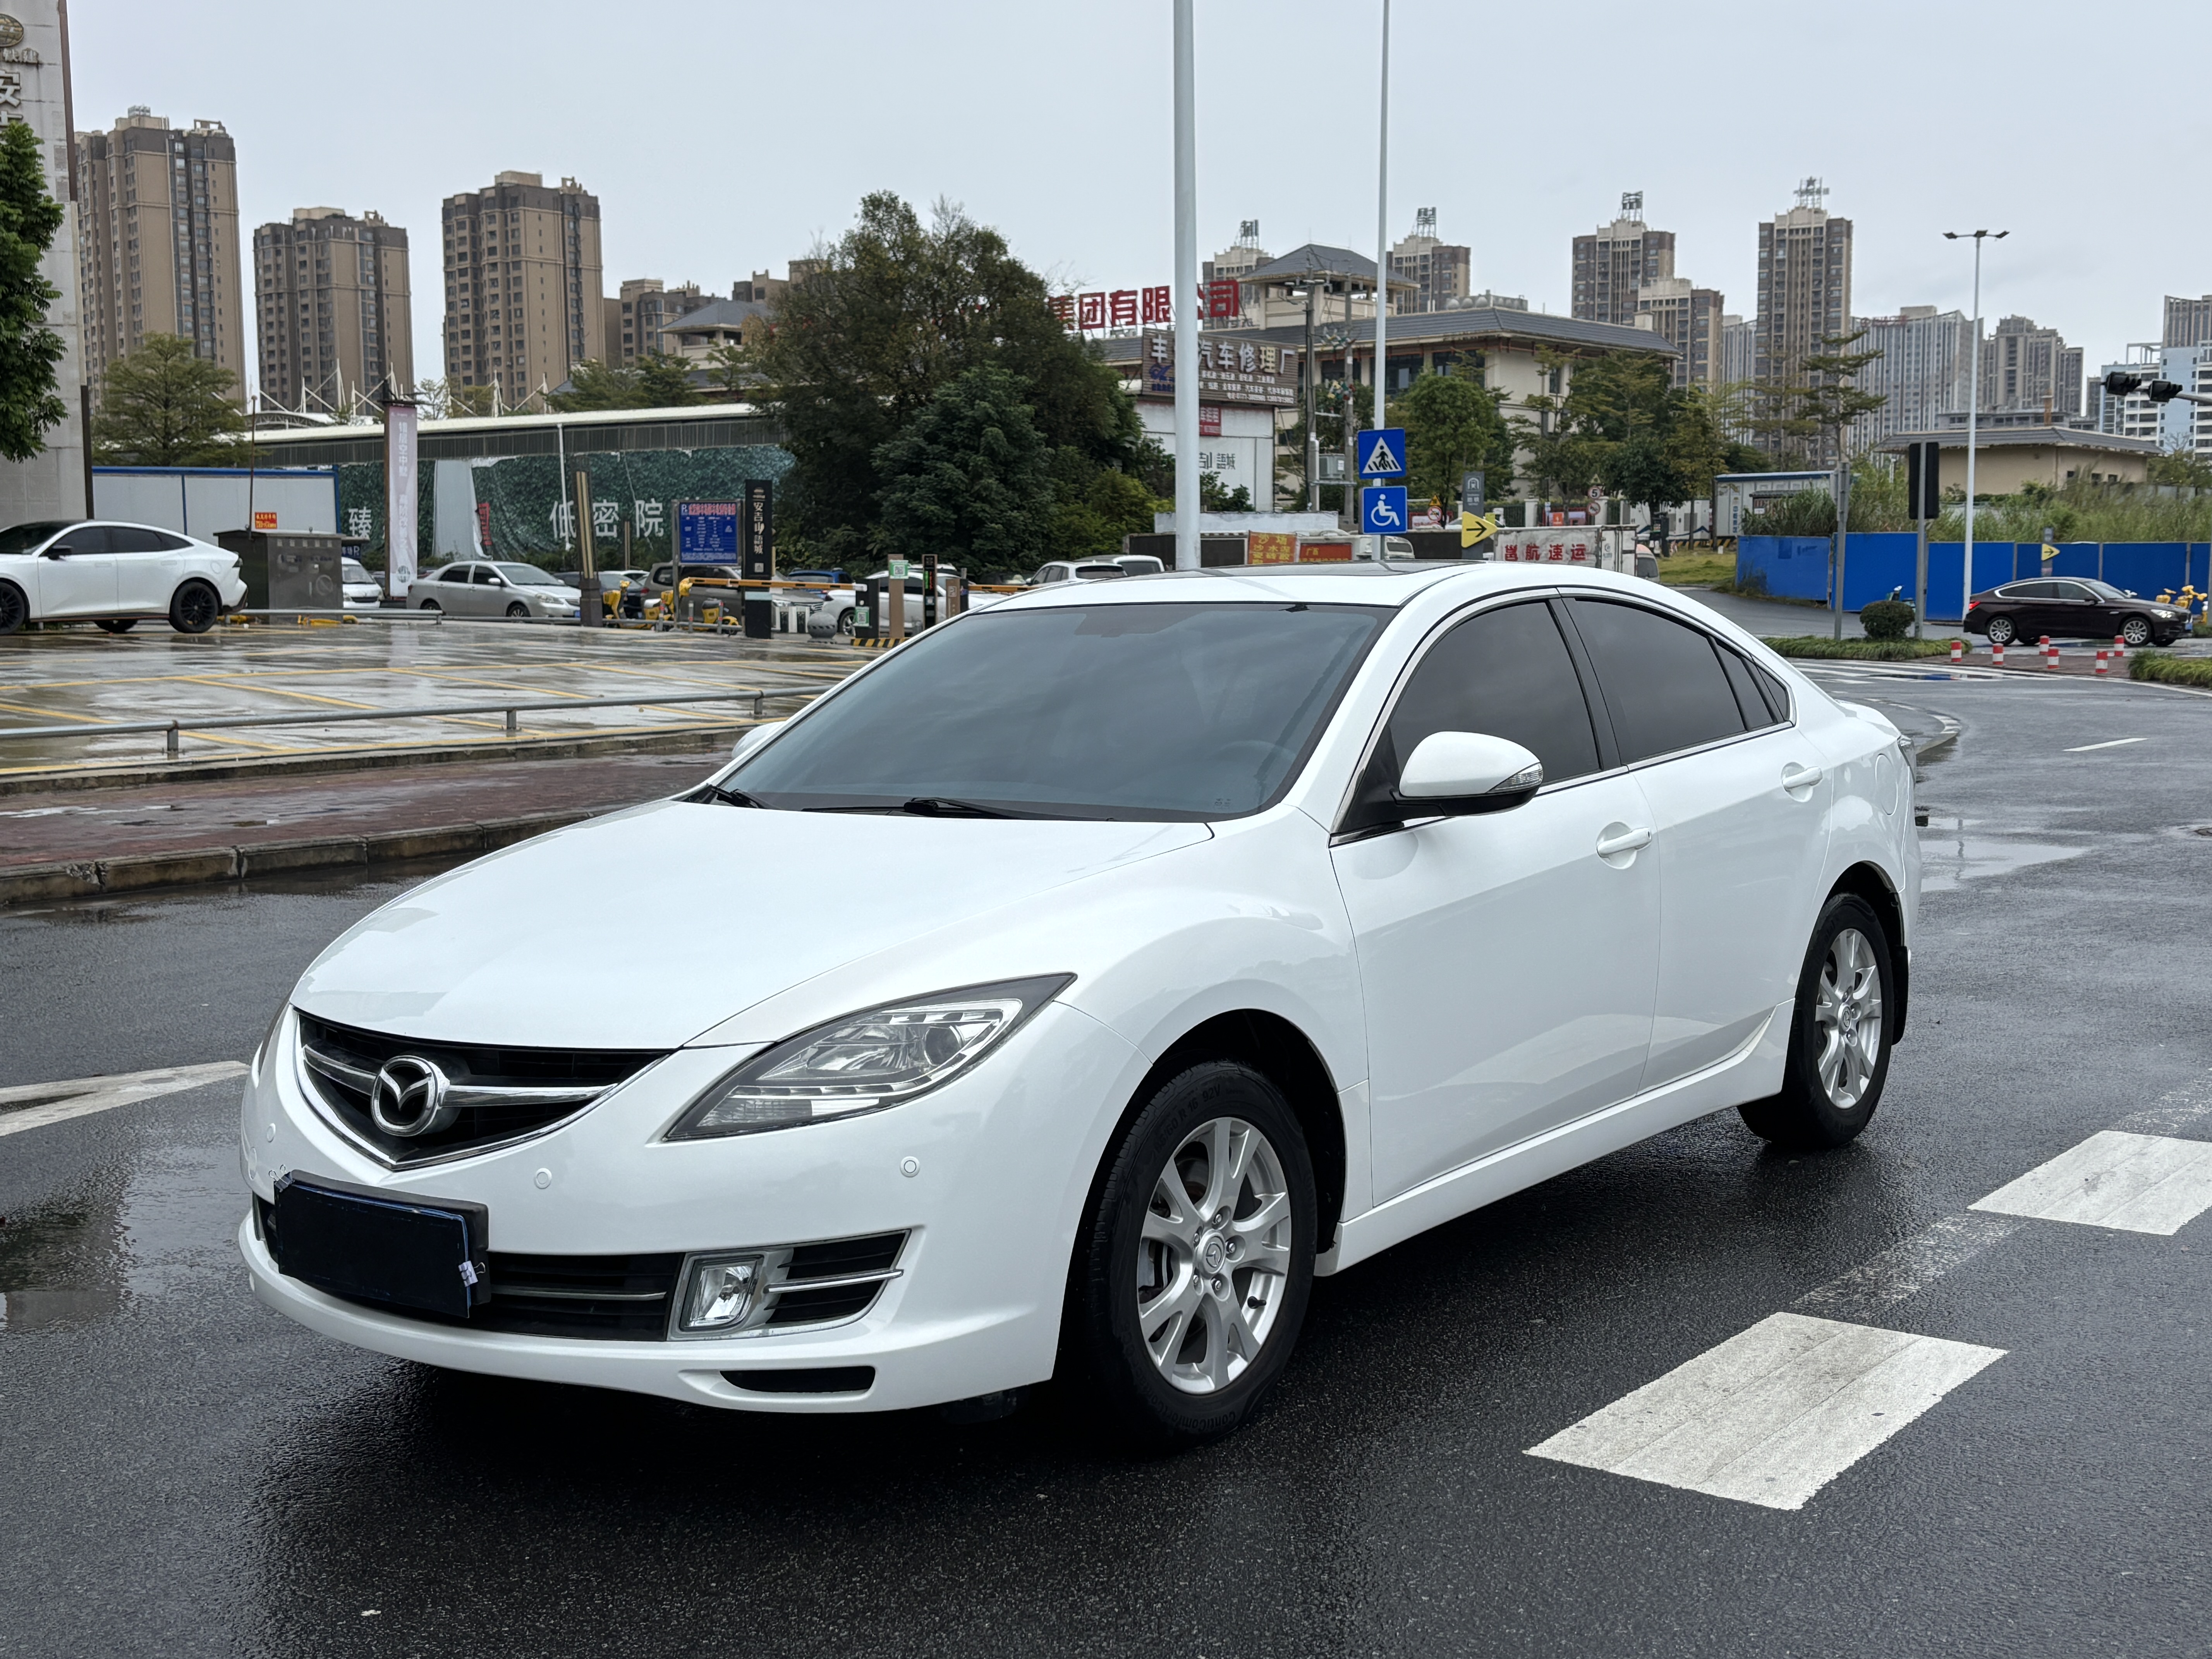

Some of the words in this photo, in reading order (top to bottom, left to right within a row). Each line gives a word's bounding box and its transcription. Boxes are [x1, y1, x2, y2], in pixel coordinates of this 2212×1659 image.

[0, 47, 38, 63] 铁建
[1048, 280, 1238, 330] 集团有限司
[1151, 334, 1295, 374] 丰汽车修理厂
[1592, 489, 1598, 497] 5
[349, 506, 372, 539] 臻
[1202, 1084, 1221, 1103] 92V
